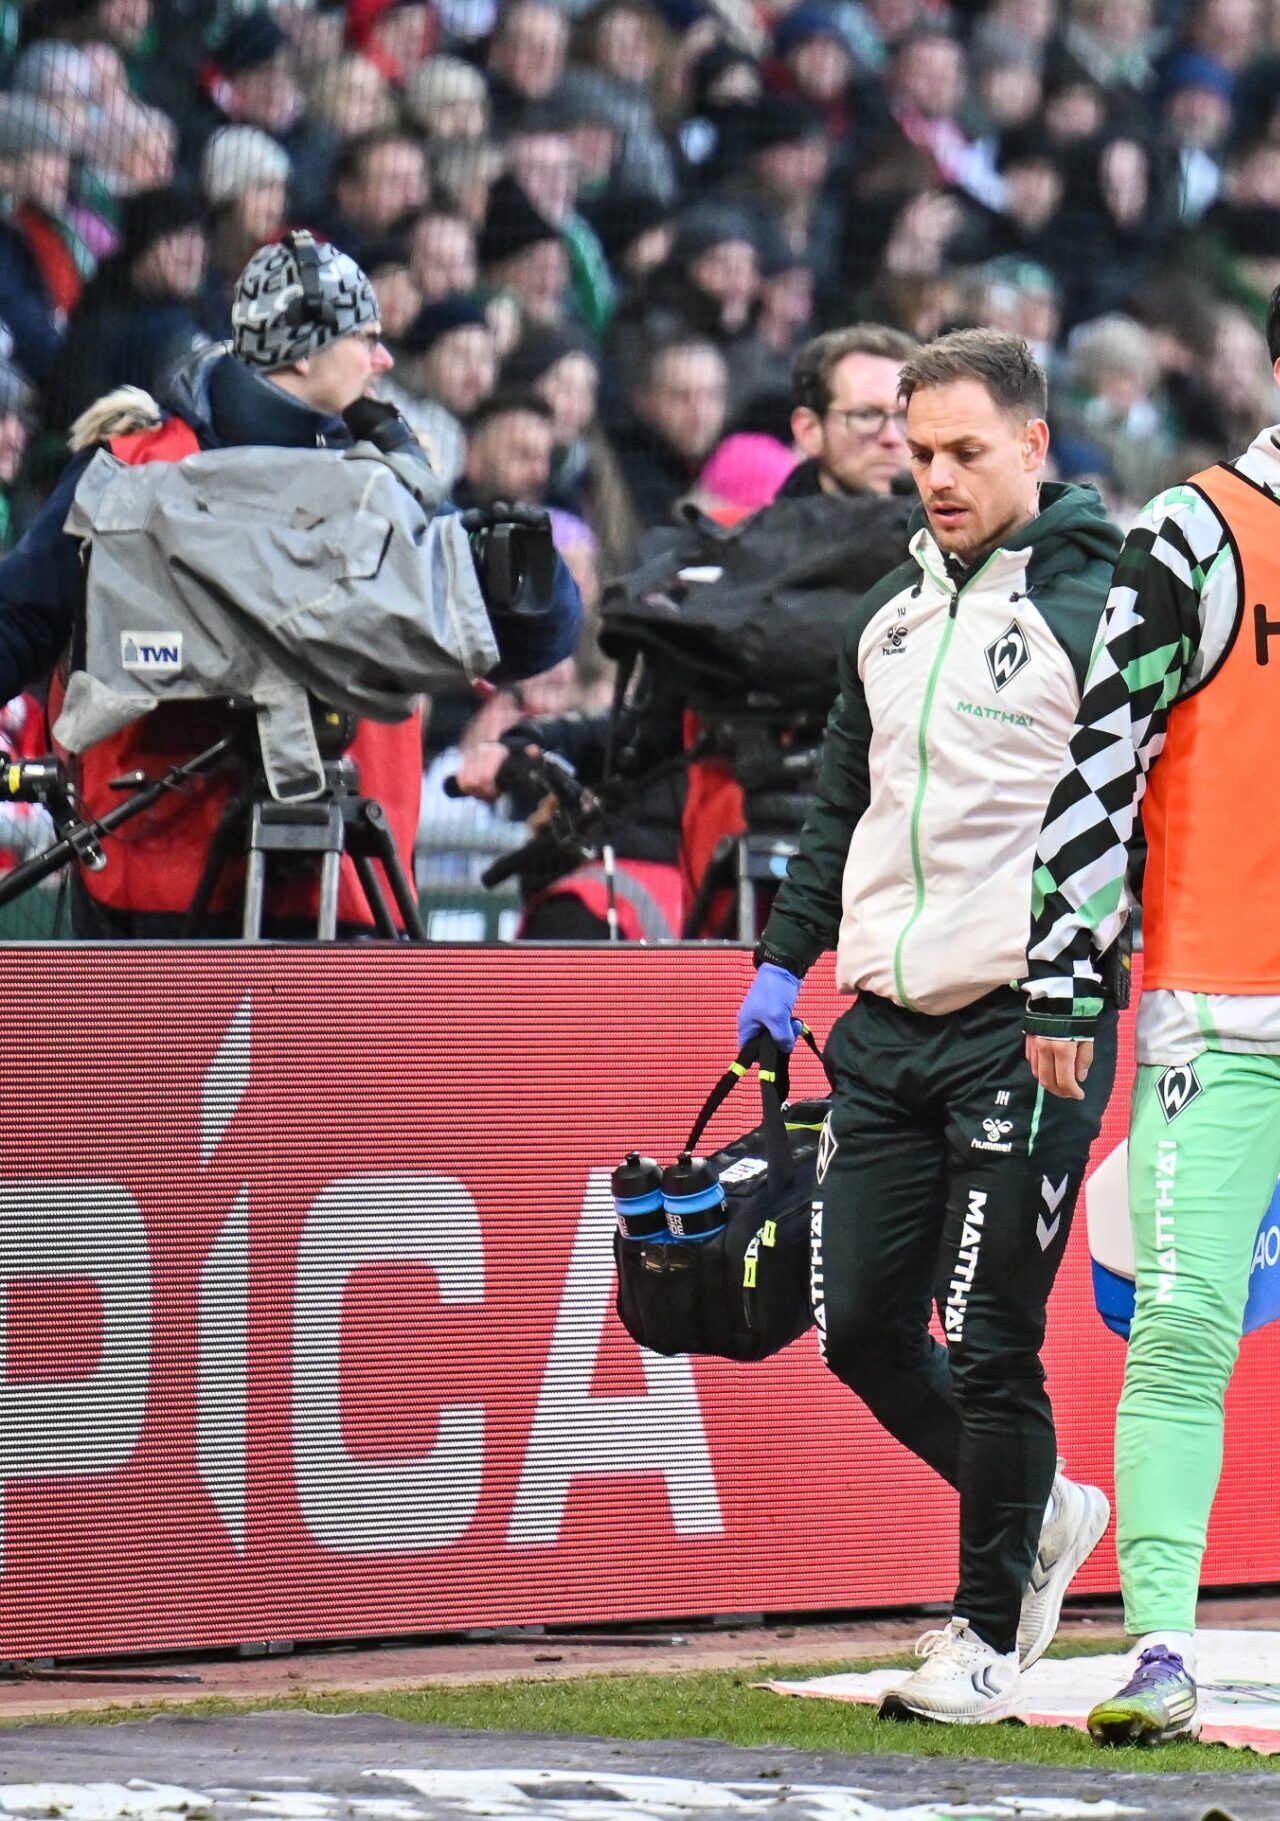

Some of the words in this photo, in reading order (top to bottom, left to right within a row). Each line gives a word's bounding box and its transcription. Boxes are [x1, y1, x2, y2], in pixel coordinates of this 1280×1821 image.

[140, 646, 178, 663] TVN
[994, 1090, 1011, 1106] JH
[970, 1137, 1013, 1153] hummel
